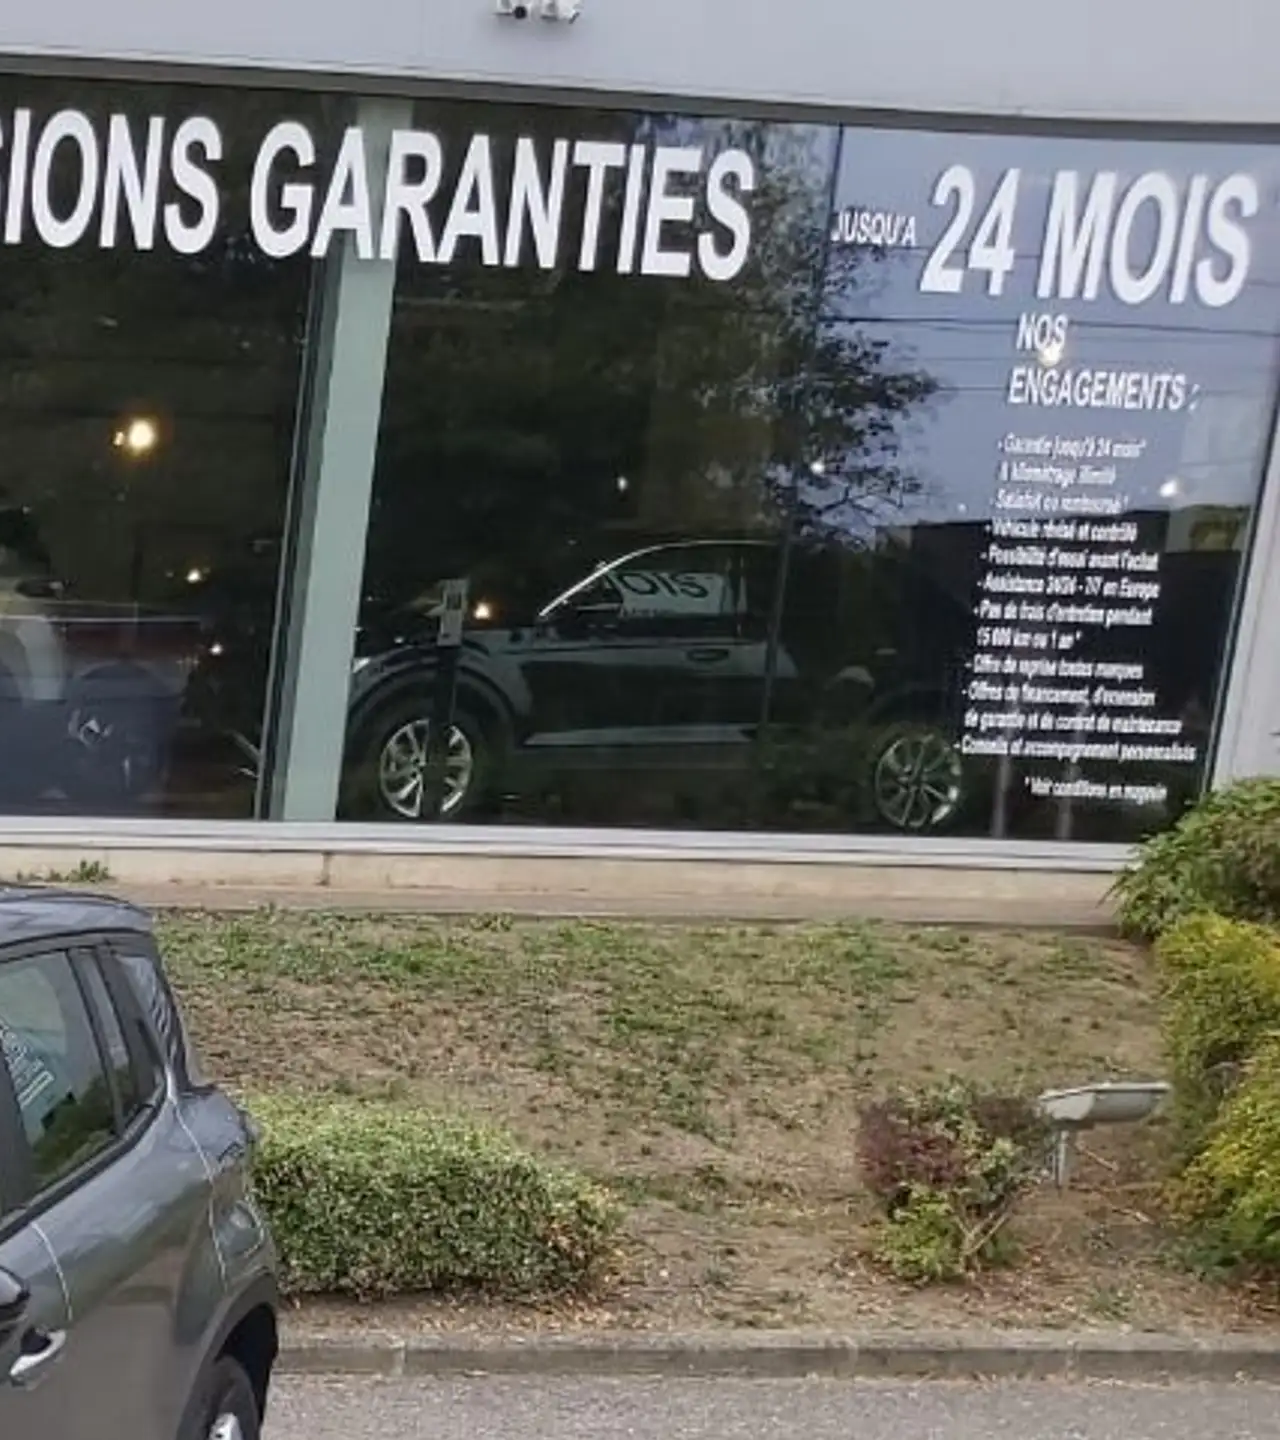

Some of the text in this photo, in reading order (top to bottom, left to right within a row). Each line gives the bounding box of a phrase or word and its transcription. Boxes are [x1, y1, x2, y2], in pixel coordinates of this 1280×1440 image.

[248, 120, 757, 282] GARANTIES
[919, 164, 1021, 297] 24
[1036, 168, 1260, 308] MOIS
[1016, 312, 1069, 352] NOS
[1008, 369, 1187, 411] ENGAGEMENTS
